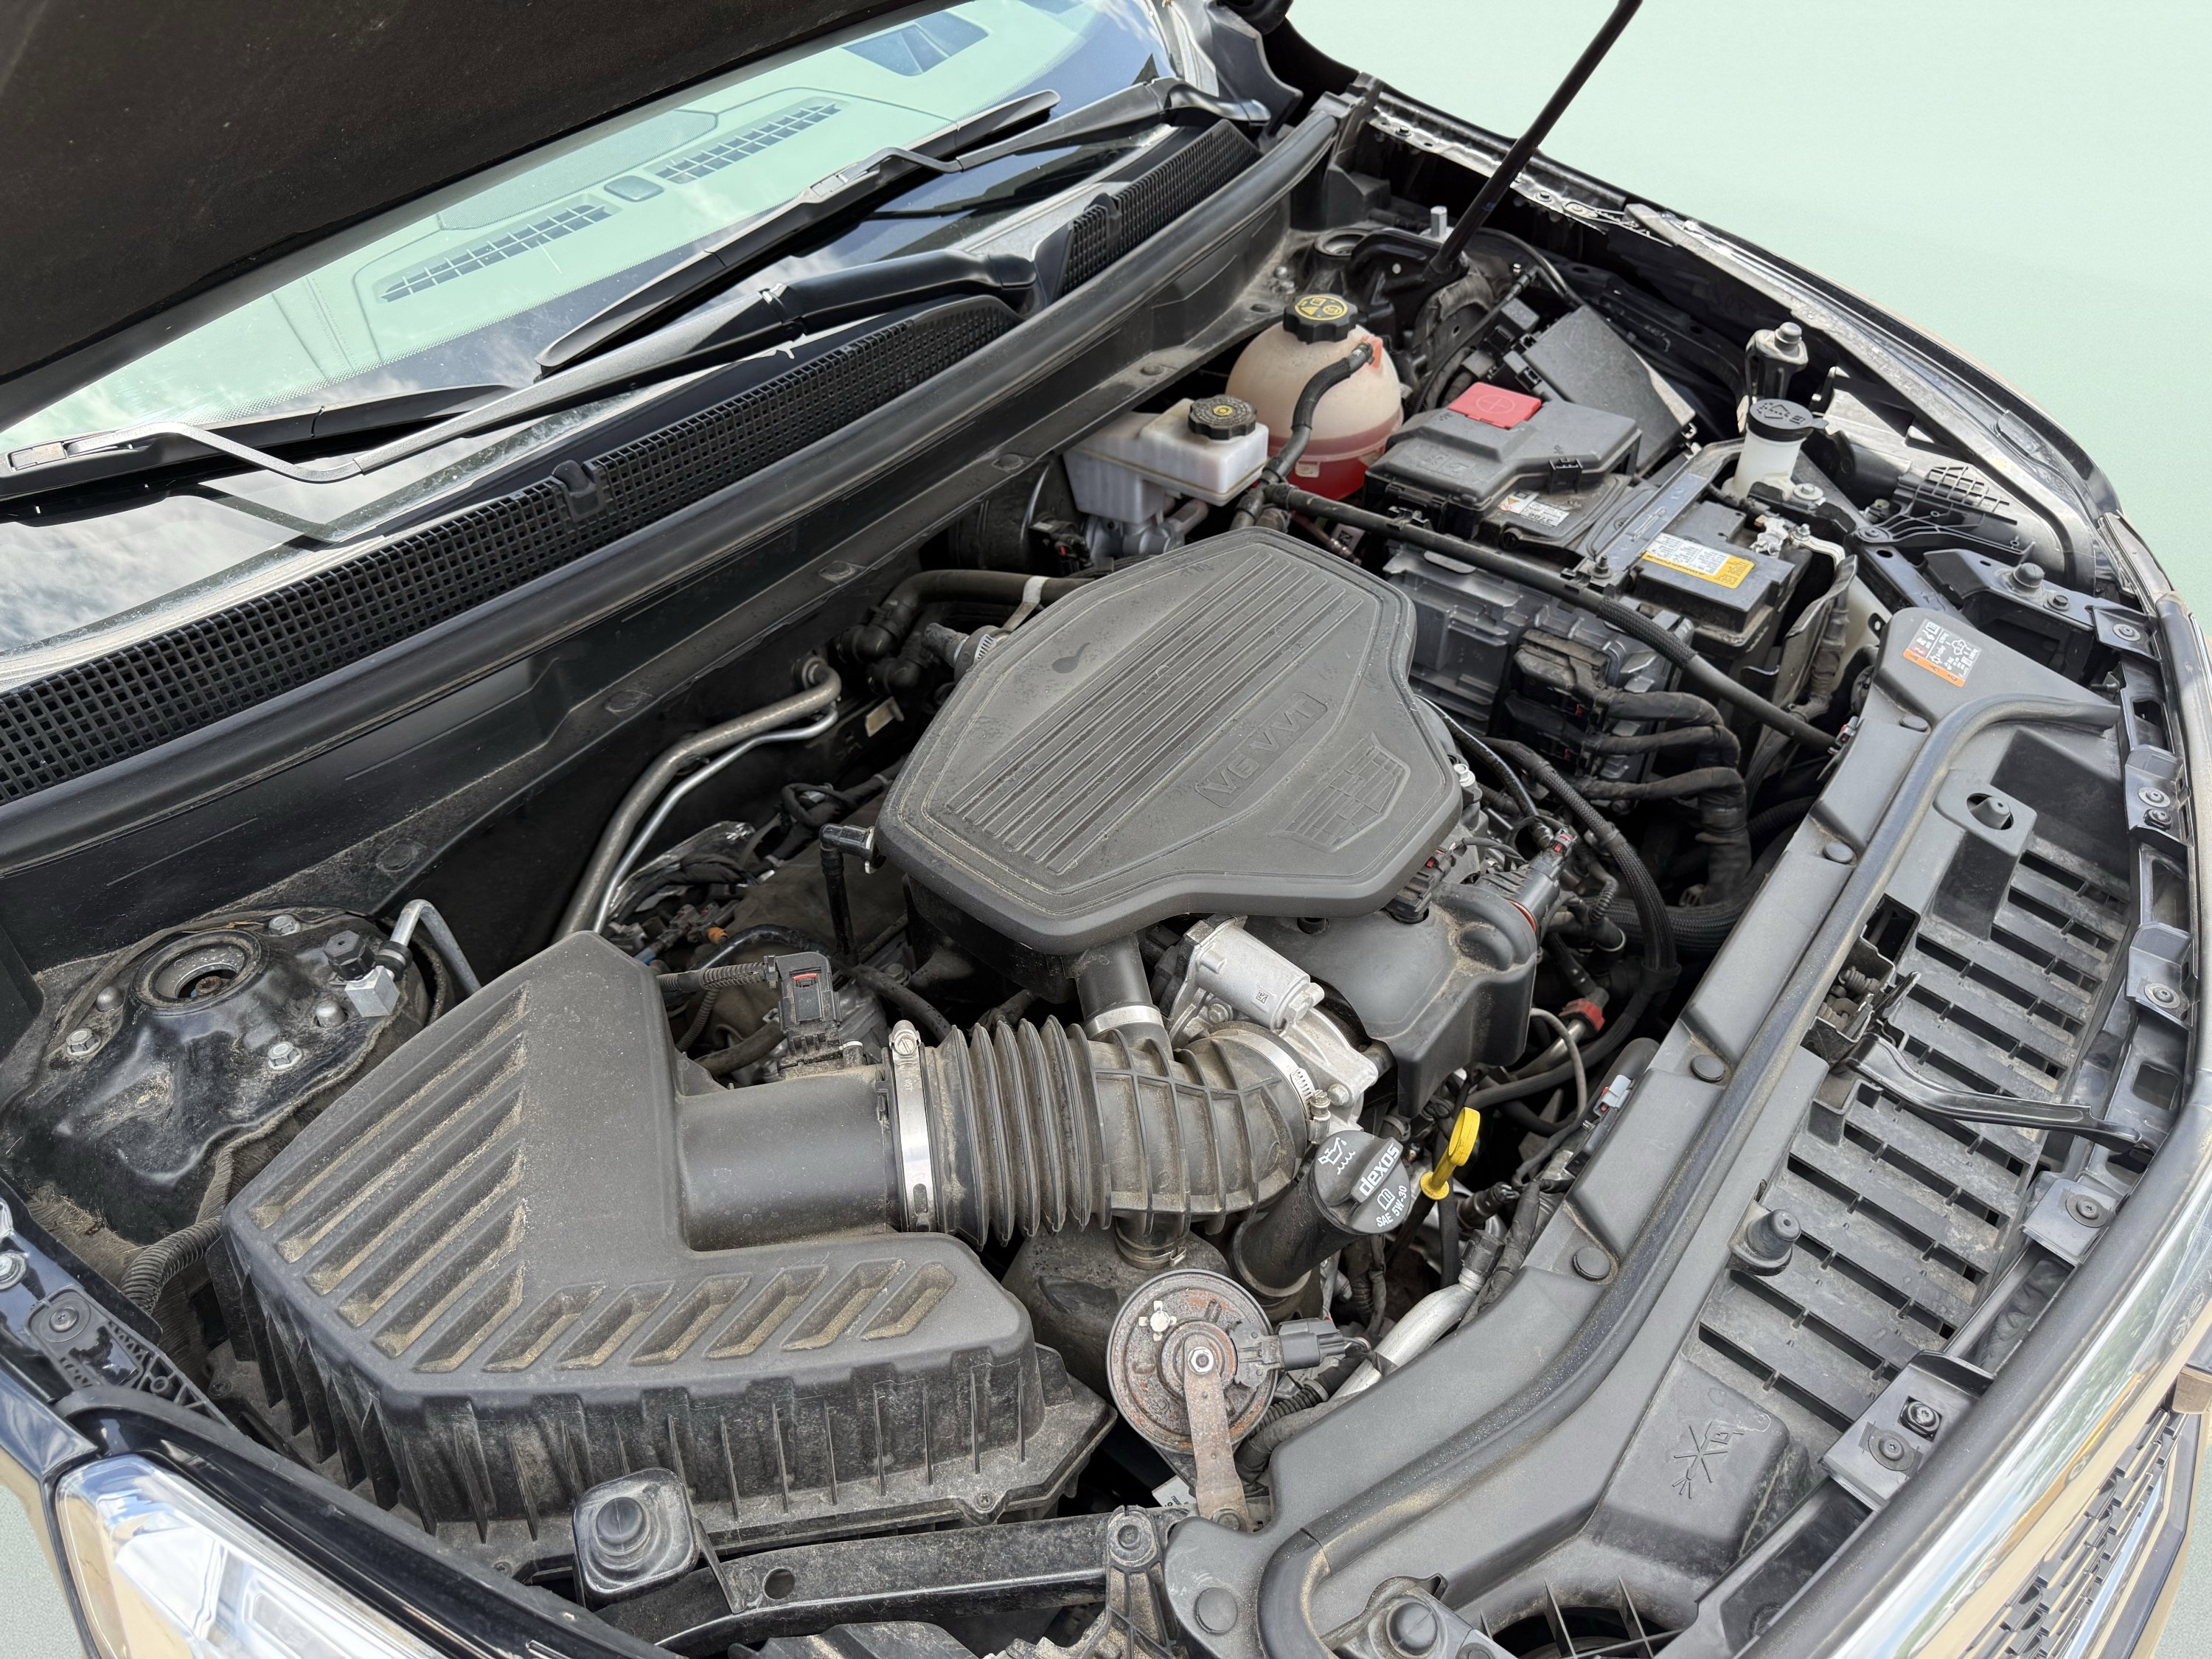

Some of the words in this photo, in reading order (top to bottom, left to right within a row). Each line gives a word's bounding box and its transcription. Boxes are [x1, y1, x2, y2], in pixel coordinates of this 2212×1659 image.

[1202, 753, 1259, 795] V6
[1359, 1142, 1400, 1197] dexos
[1376, 1212, 1394, 1228] SAE
[1391, 1185, 1408, 1217] 5W-30
